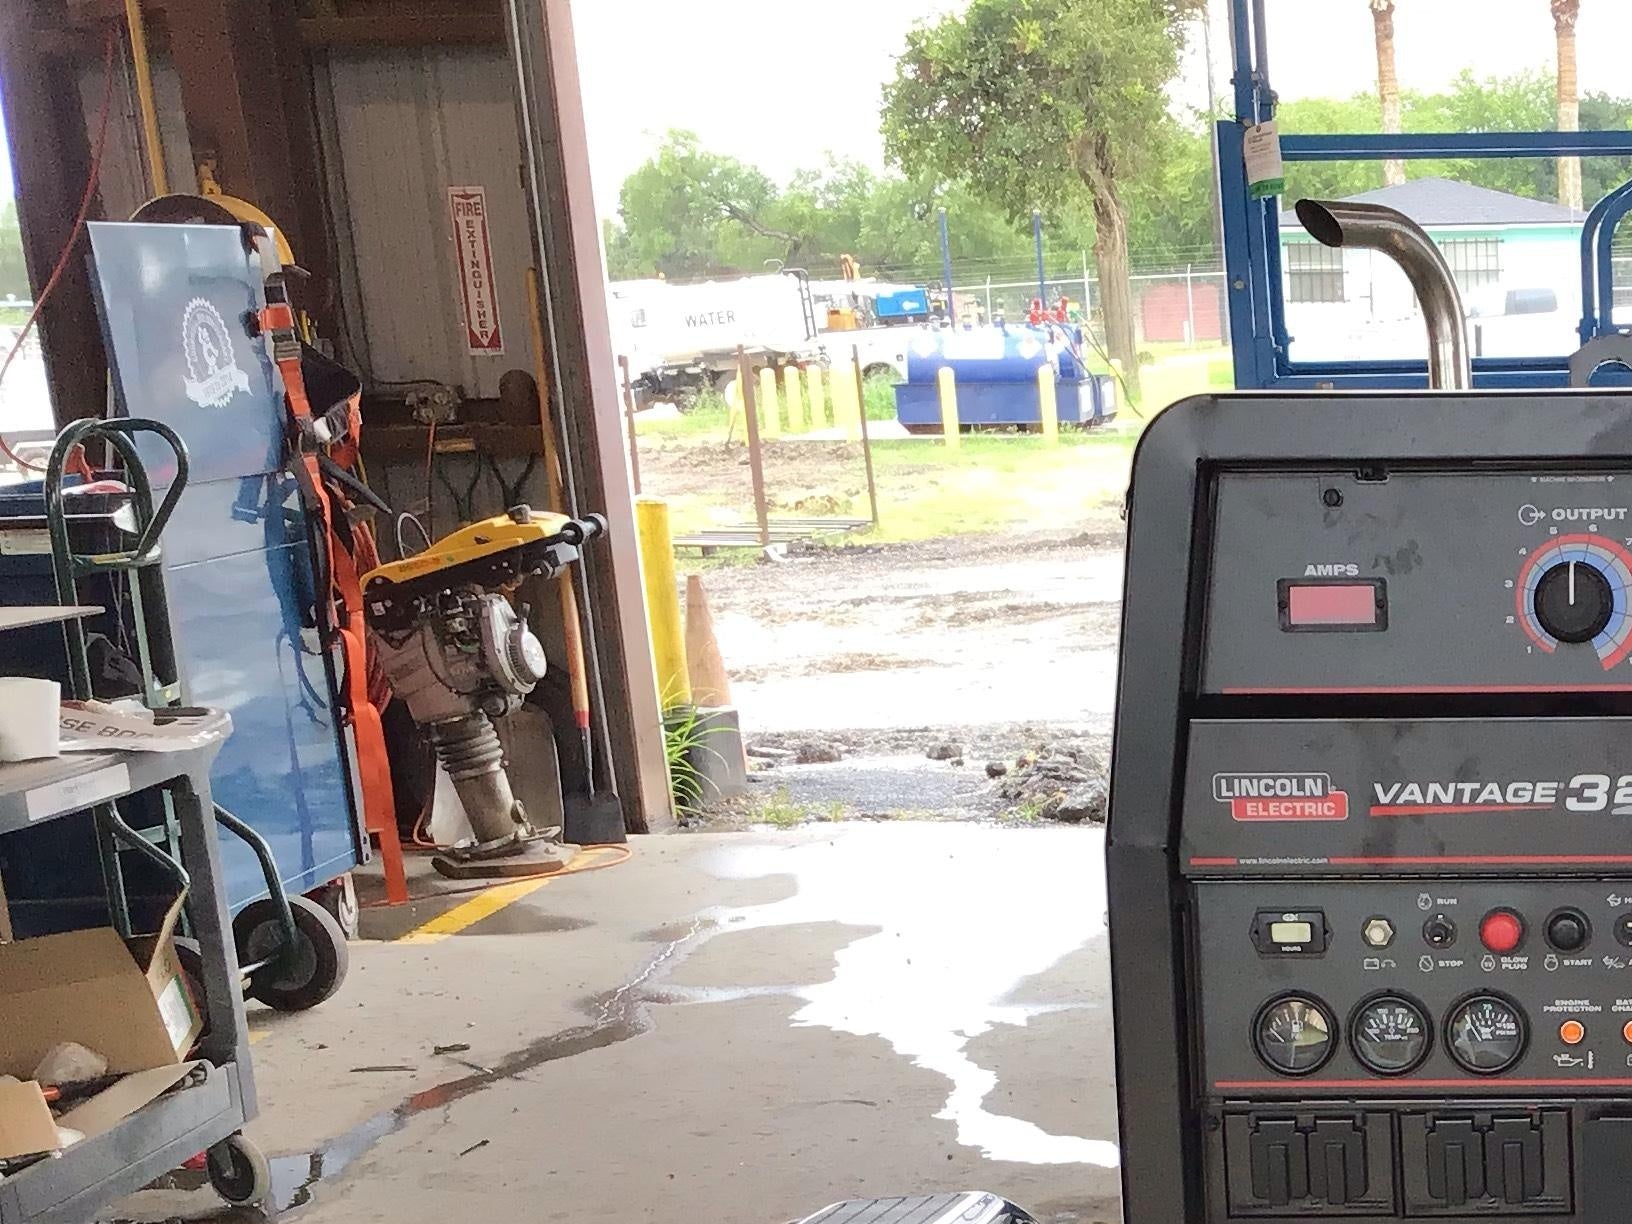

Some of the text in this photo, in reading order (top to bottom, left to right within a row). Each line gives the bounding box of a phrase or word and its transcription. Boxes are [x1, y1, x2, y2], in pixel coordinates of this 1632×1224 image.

[455, 202, 482, 217] FIRE
[465, 219, 490, 339] EXTINGUISHER
[685, 310, 735, 327] WATER
[1552, 508, 1628, 521] OUTPUT
[1304, 564, 1359, 577] AMPS
[1220, 778, 1324, 797] LINCOLN
[1373, 782, 1560, 804] VANTAGE
[1246, 802, 1336, 816] ELECTRIC
[1239, 856, 1329, 865] www.lincolnelectric.com
